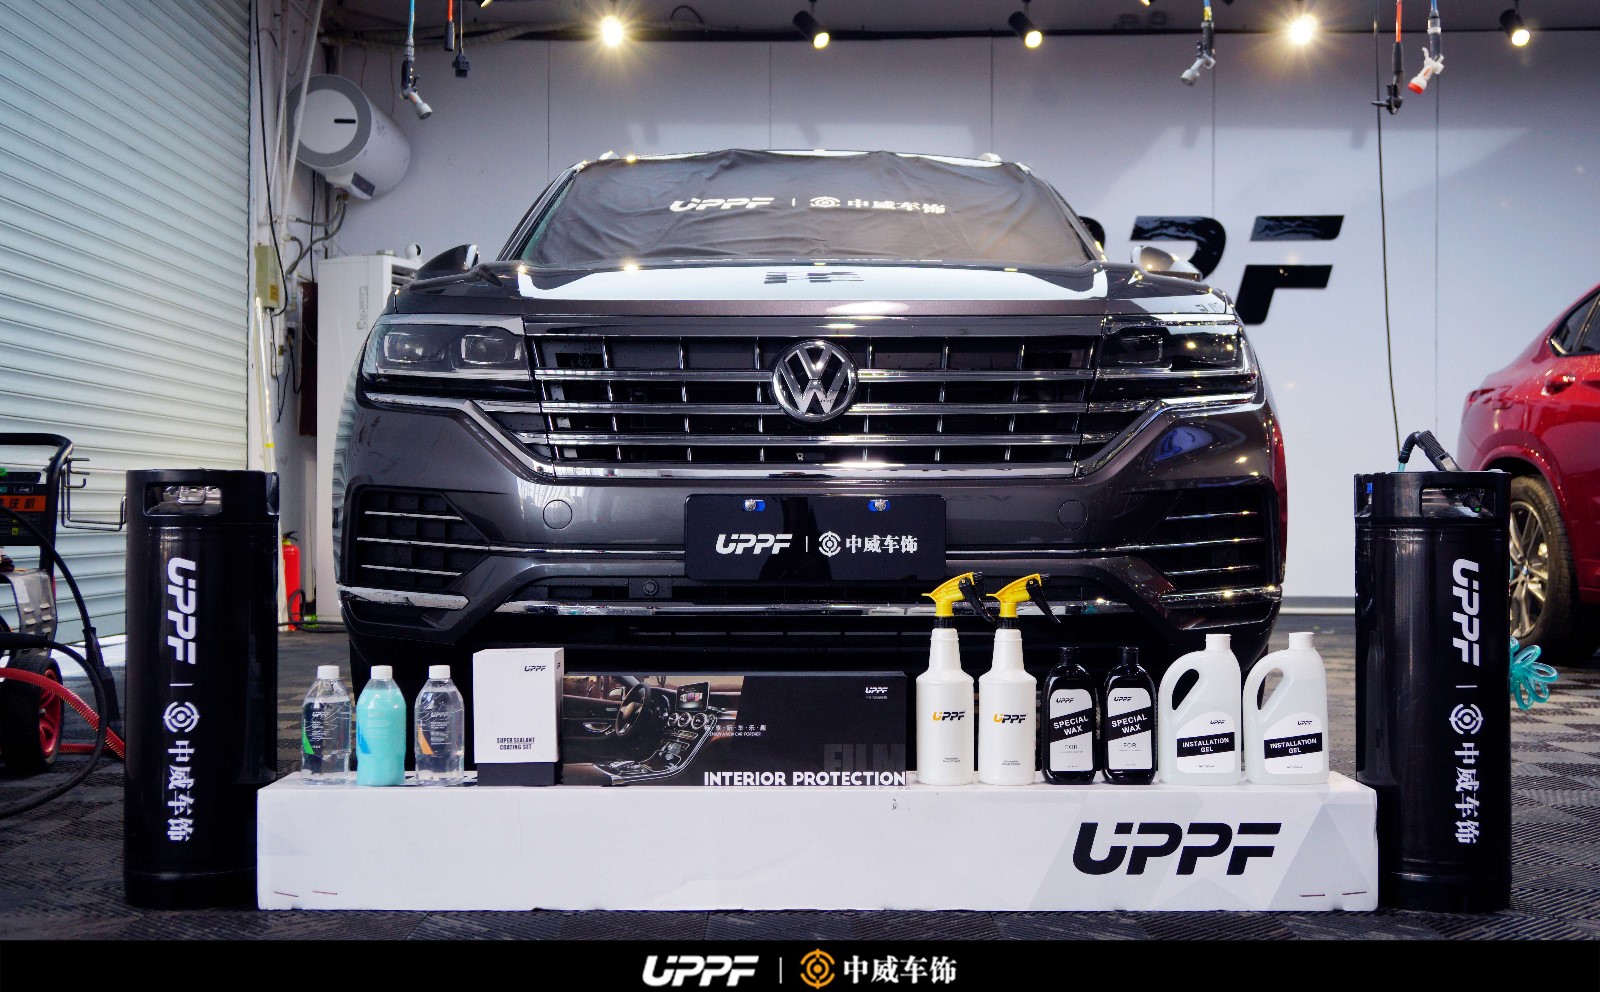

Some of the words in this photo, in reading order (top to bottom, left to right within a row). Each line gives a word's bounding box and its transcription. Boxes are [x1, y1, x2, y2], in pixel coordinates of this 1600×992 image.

[669, 197, 775, 212] UPPF
[846, 198, 946, 214] 中威车饰
[1079, 214, 1345, 325] PF
[715, 533, 793, 555] UPPF
[845, 534, 919, 554] 中威车饰
[167, 557, 196, 665] UPPF
[1452, 558, 1480, 667] UPPF
[865, 686, 888, 694] UPPF
[932, 709, 966, 721] UPPF
[993, 713, 1027, 724] UPPF
[1053, 715, 1089, 729] SPECIAL
[1111, 713, 1148, 728] SPECIAL
[1063, 725, 1083, 736] WAX
[1121, 723, 1141, 734] WAX
[1182, 737, 1230, 748] INSTALLATION
[1269, 737, 1317, 749] INSTALLATION
[704, 771, 786, 786] INTERIOR
[792, 771, 906, 786] PROTECTION
[168, 740, 195, 842] 中威车饰
[1454, 742, 1480, 844] 中威车饰
[1072, 822, 1283, 876] UPPF
